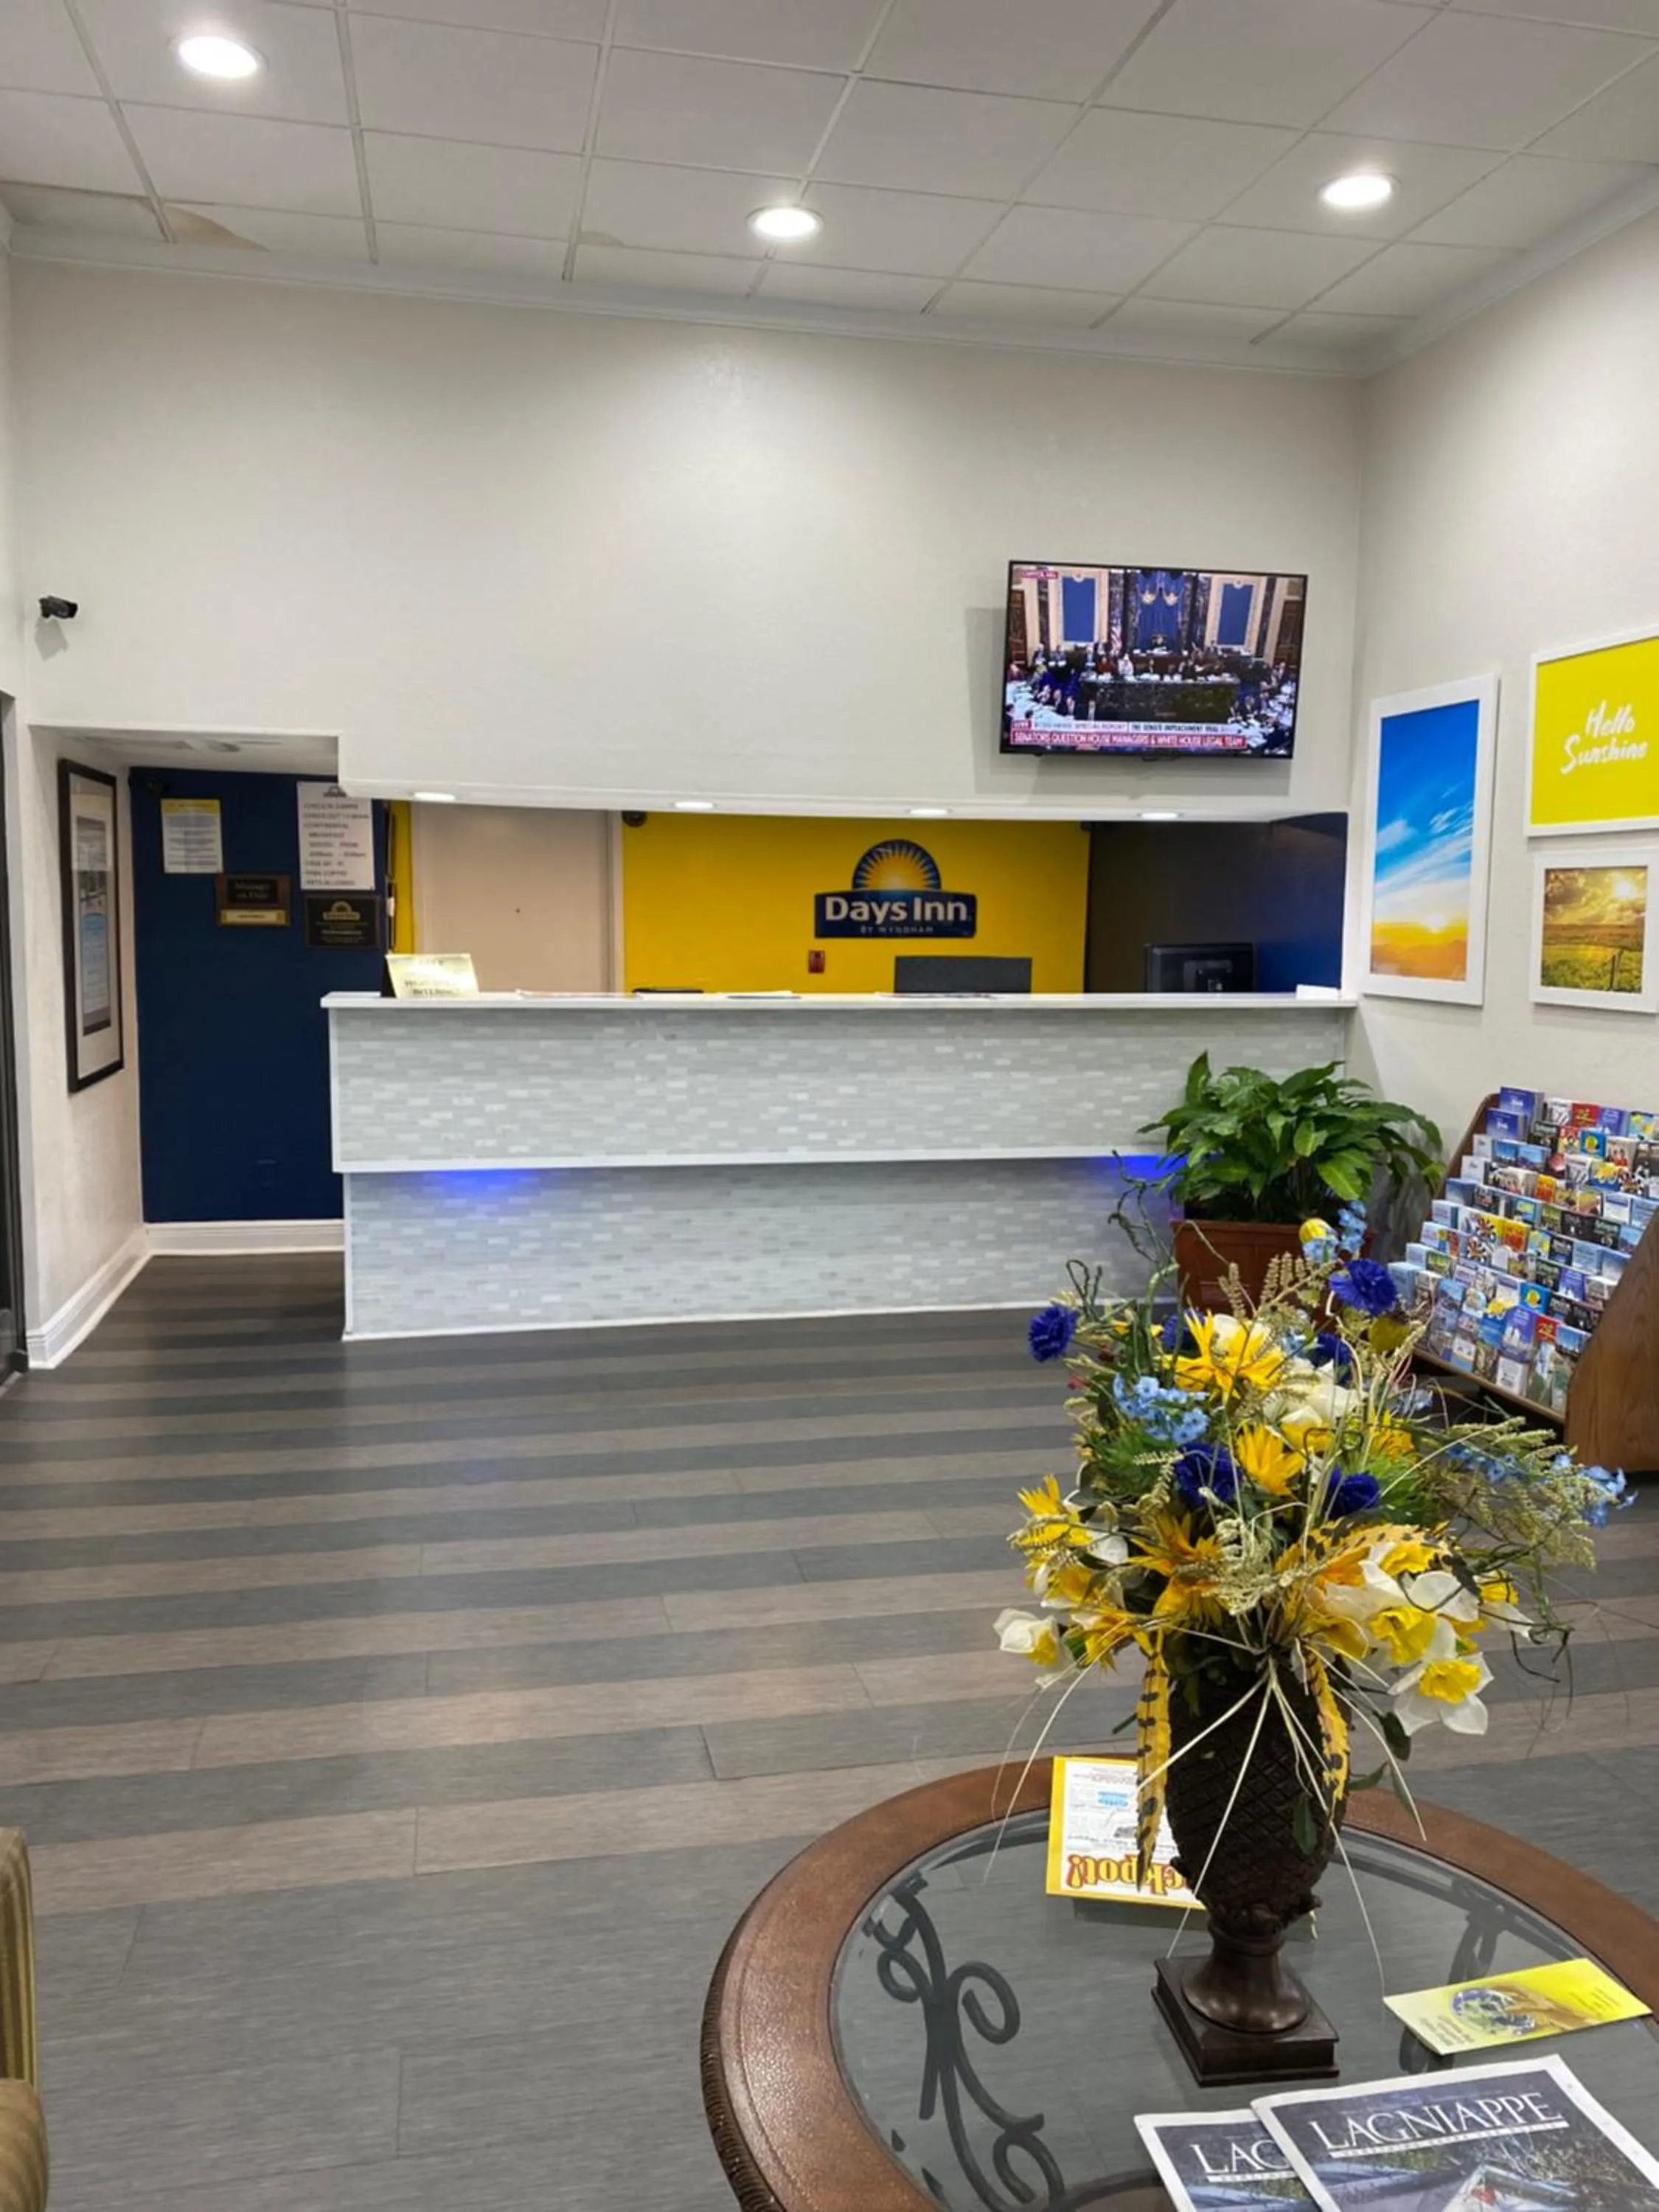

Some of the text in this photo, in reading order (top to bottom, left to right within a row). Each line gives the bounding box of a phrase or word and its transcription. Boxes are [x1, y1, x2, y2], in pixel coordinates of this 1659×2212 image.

[1585, 698, 1635, 738] Hello
[1559, 733, 1649, 775] Sunshine
[825, 897, 967, 924] Days Inn
[1309, 2093, 1562, 2150] LAGNIAPPE
